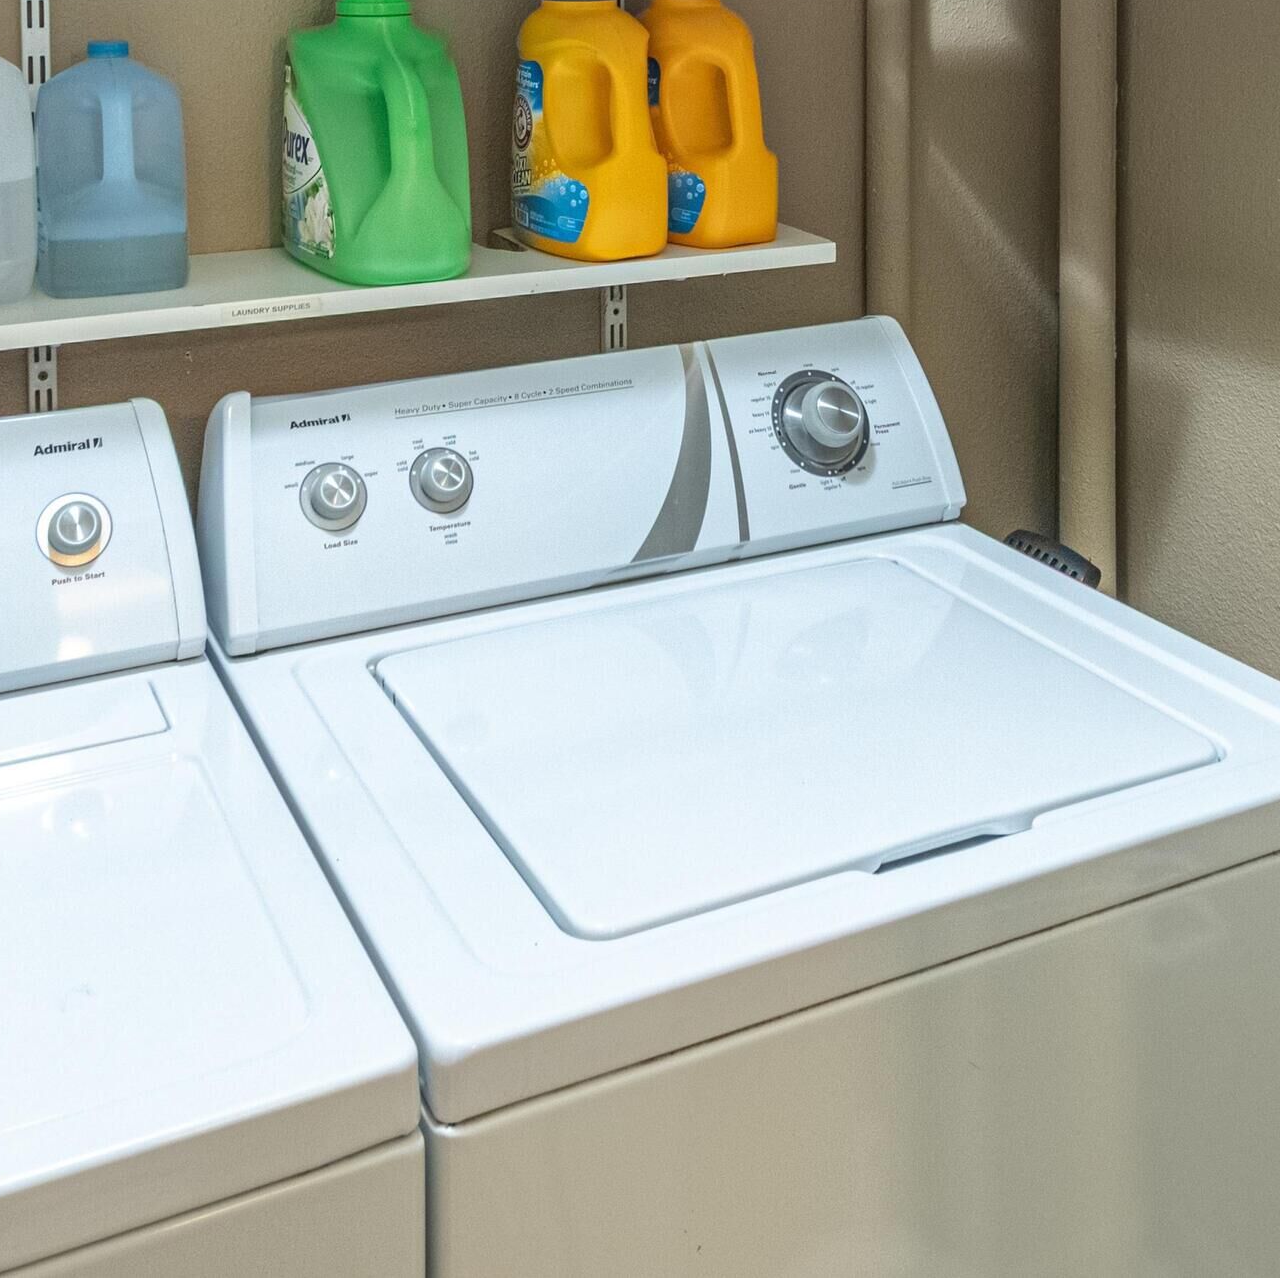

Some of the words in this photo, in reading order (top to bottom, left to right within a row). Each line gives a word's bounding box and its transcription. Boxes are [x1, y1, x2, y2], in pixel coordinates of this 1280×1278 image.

[232, 306, 270, 317] LAUNDRY
[272, 302, 311, 313] SUPPLIES
[395, 406, 420, 416] Heavy
[422, 404, 441, 413] Duty
[448, 400, 472, 410] Super
[474, 395, 508, 406] Capacity
[521, 390, 542, 400] Cycle
[555, 385, 580, 396] Speed
[580, 378, 633, 391] Combinations
[290, 416, 340, 430] Admiral
[33, 439, 90, 457] Admiral
[429, 521, 471, 532] Temperature
[324, 540, 342, 550] Load
[343, 539, 358, 547] Size
[51, 576, 72, 586] Push
[84, 571, 106, 582] Start
